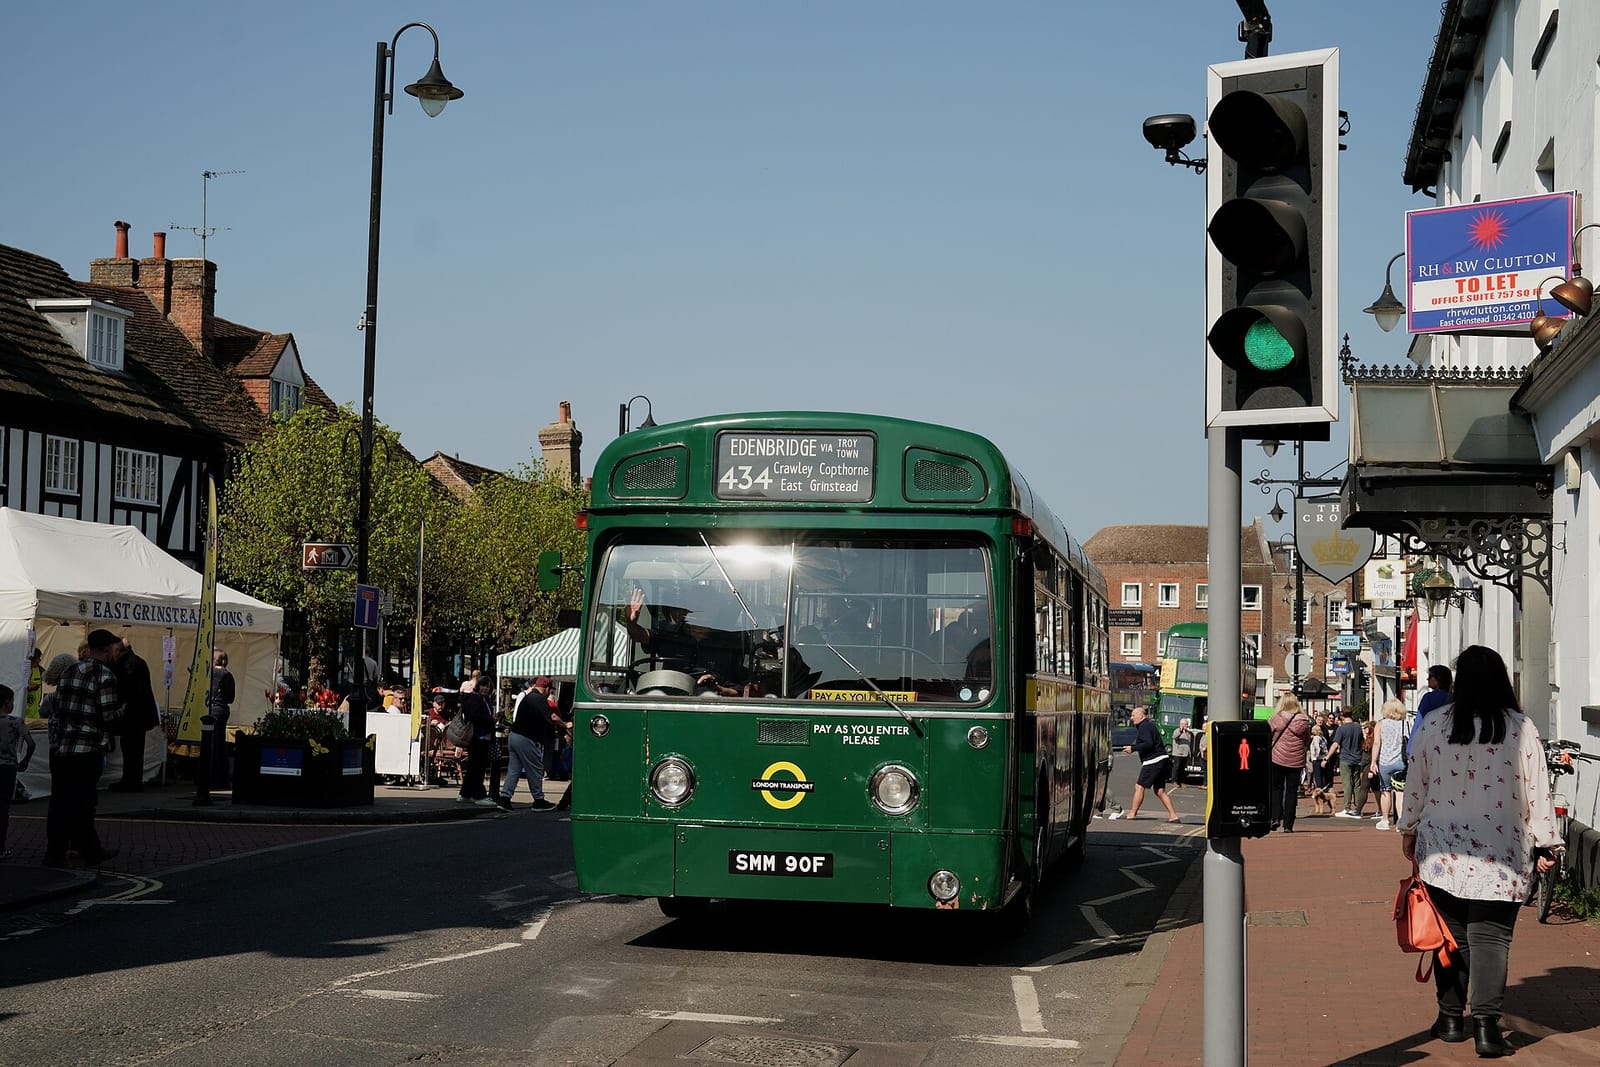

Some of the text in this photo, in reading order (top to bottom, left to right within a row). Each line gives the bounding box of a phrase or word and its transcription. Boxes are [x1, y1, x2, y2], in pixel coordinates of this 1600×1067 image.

[1419, 252, 1556, 277] RH & RW CLUTTON
[1455, 273, 1518, 294] TO LET
[1431, 294, 1464, 305] OFFICE
[1466, 291, 1494, 302] SUITE
[1497, 290, 1514, 299] 757
[1517, 289, 1530, 298] SQ
[1447, 302, 1530, 318] rhrwclutton.com
[1440, 310, 1538, 327] East Grinstead 01342 4101
[731, 438, 833, 457] EDENBRIDGE VIA
[837, 439, 858, 448] TROY
[836, 449, 859, 458] TOWN
[719, 466, 773, 490] 434
[773, 462, 869, 478] Crawley Copthorne
[781, 478, 859, 492] East Grinstead
[93, 601, 243, 627] EAST GRINSTEA IONS
[815, 693, 832, 701] PAY
[814, 725, 910, 735] PAY AS YOU ENTER
[843, 736, 880, 745] PLEASE
[736, 854, 825, 873] SMM 90F
